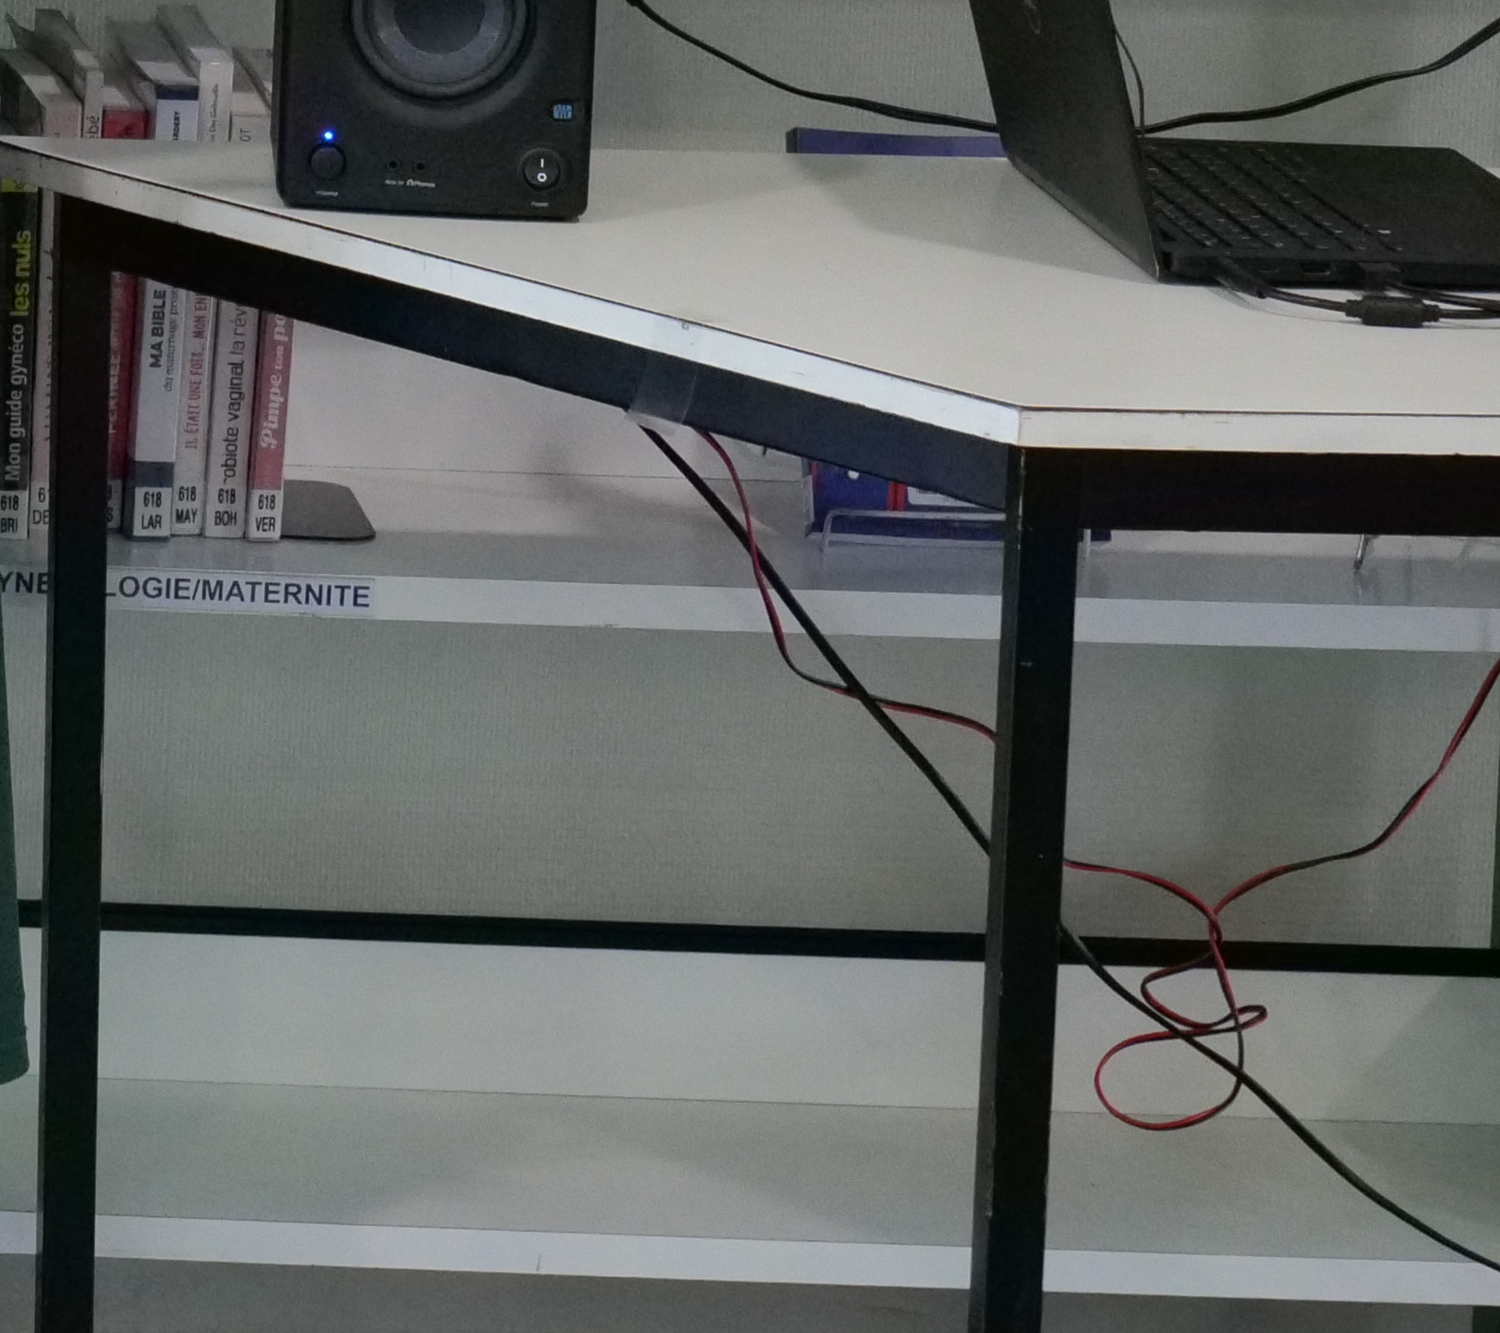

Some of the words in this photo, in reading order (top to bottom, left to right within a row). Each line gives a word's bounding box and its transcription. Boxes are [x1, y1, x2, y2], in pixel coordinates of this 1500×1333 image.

[149, 289, 167, 339] BIBLE
[149, 341, 163, 368] MA
[143, 491, 162, 507] 618
[141, 514, 162, 529] LAR
